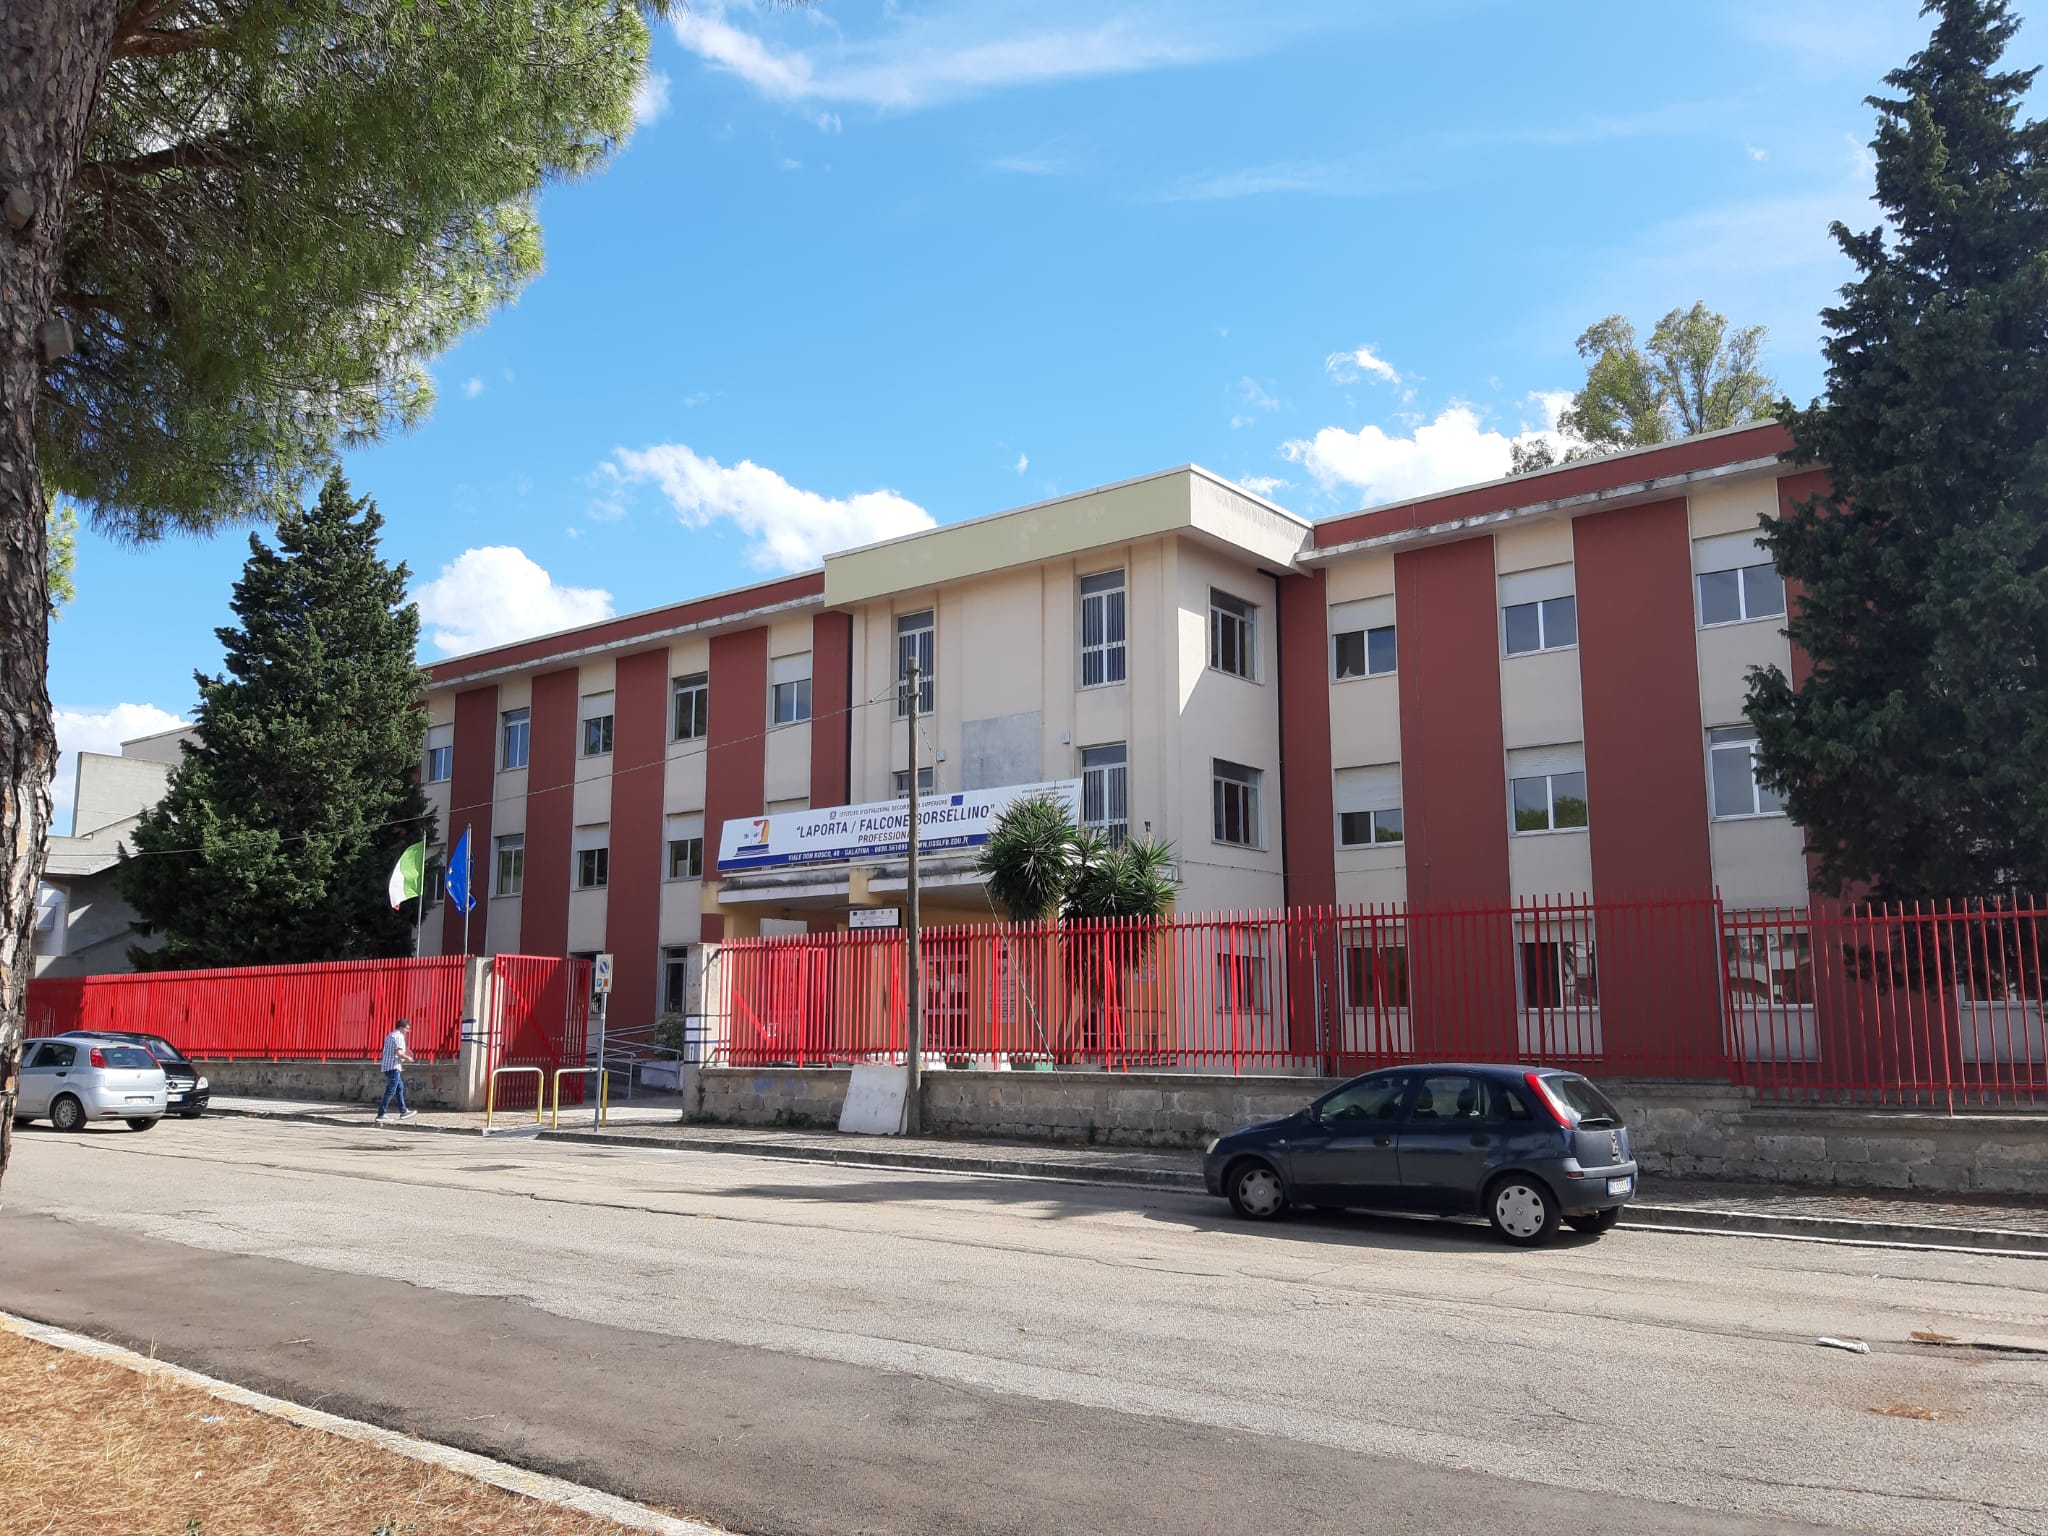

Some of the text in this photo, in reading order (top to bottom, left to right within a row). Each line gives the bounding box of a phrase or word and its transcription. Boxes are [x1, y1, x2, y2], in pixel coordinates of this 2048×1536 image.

[859, 814, 909, 832] FALCONE
[858, 829, 921, 843] PROFESSION
[802, 852, 813, 860] DON
[845, 847, 870, 856] GALATINA
